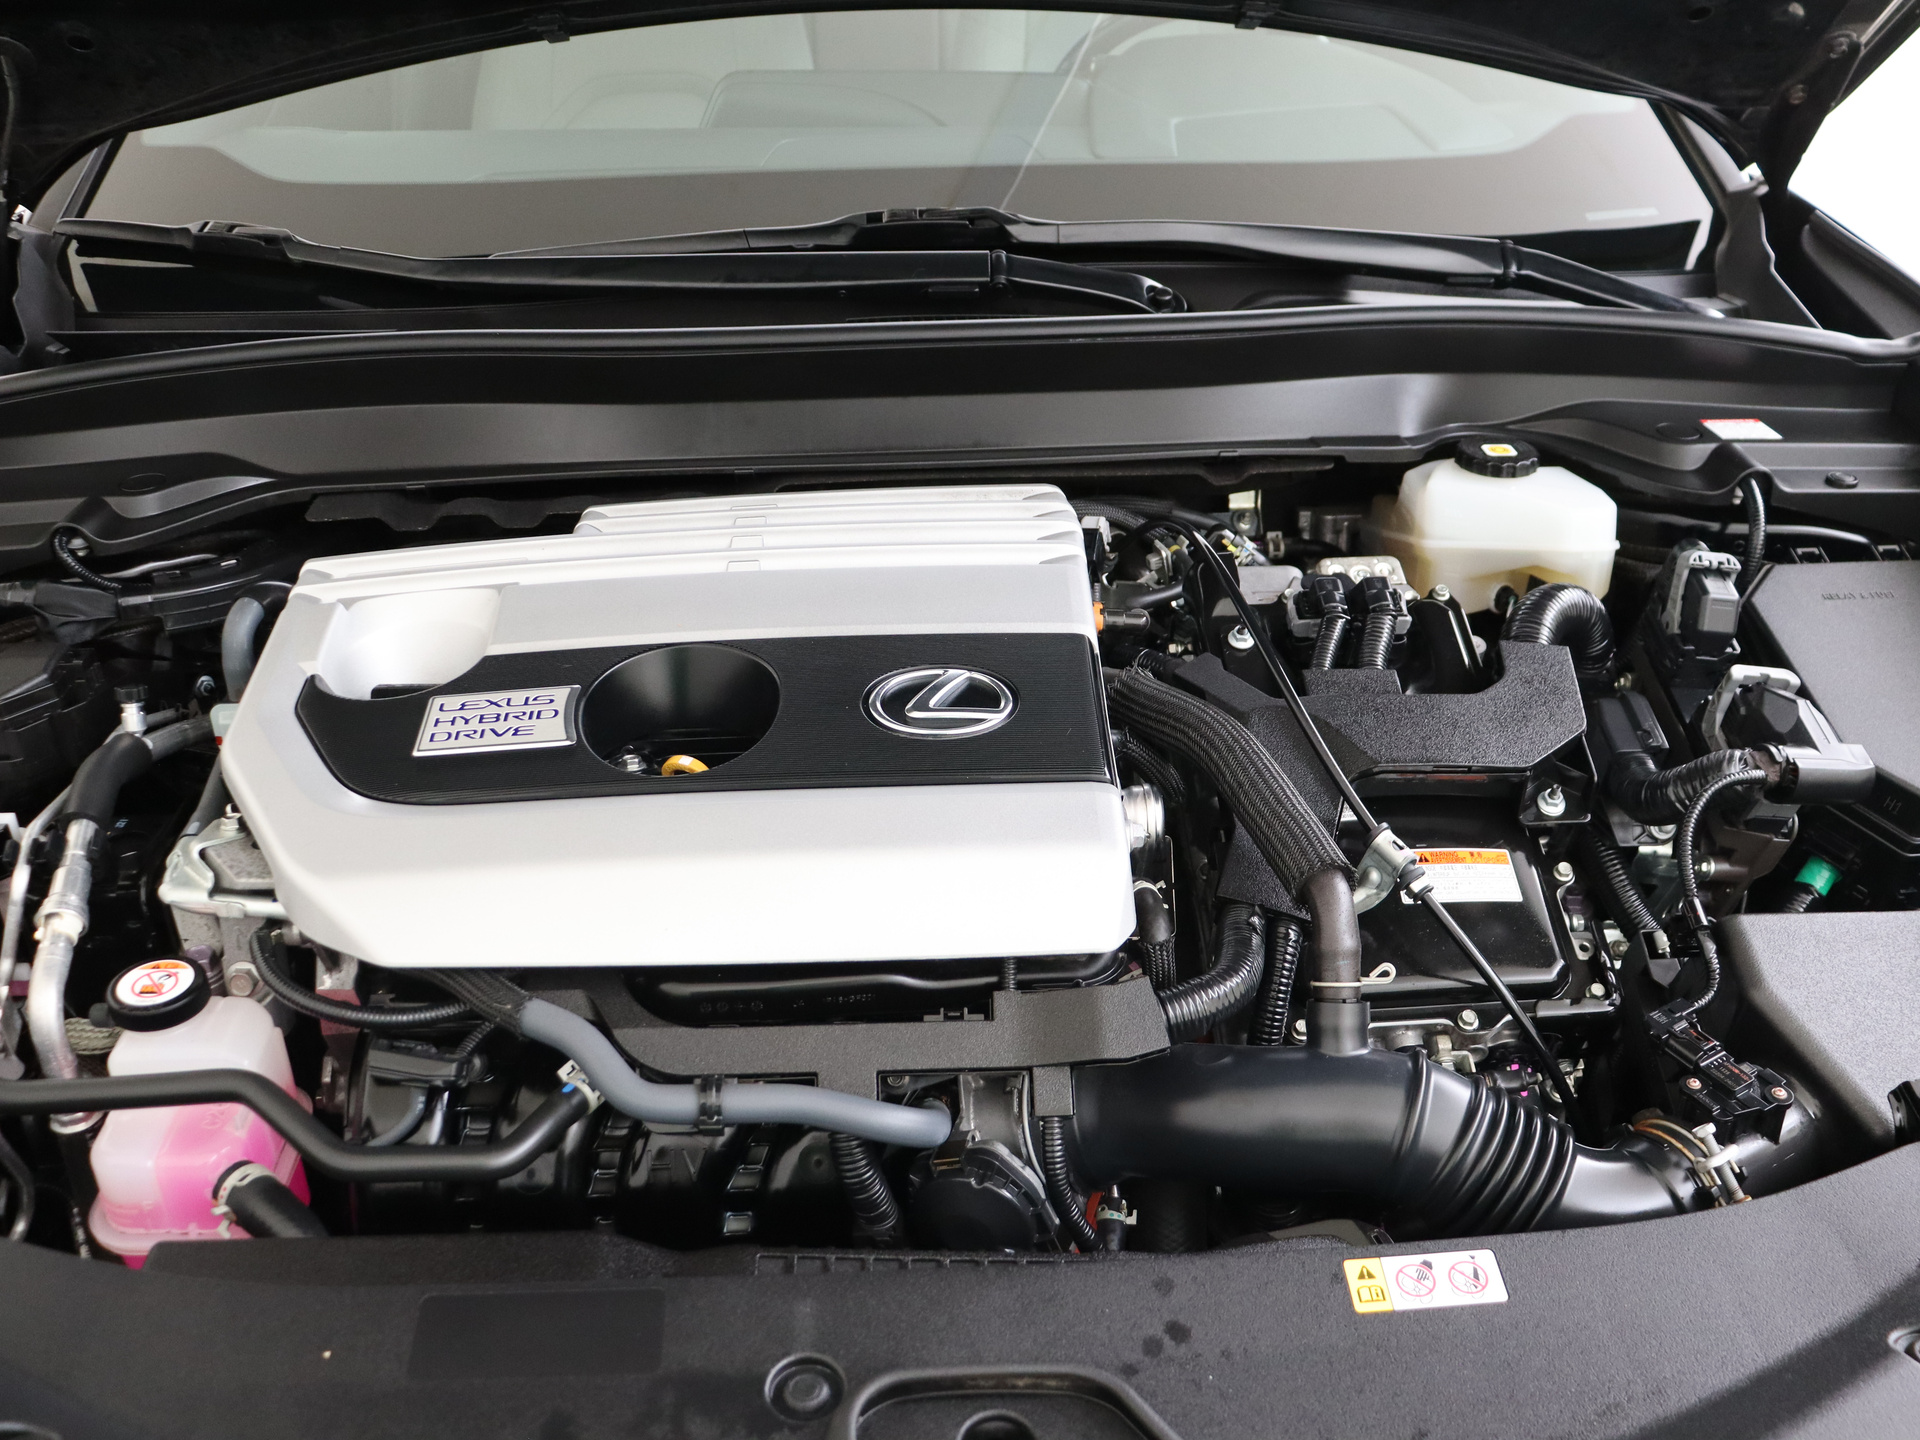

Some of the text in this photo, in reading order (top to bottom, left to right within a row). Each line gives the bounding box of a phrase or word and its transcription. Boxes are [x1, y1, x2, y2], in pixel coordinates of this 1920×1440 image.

[438, 694, 556, 712] LEXUS
[433, 708, 560, 727] HYBRID
[429, 724, 537, 742] DRIVE
